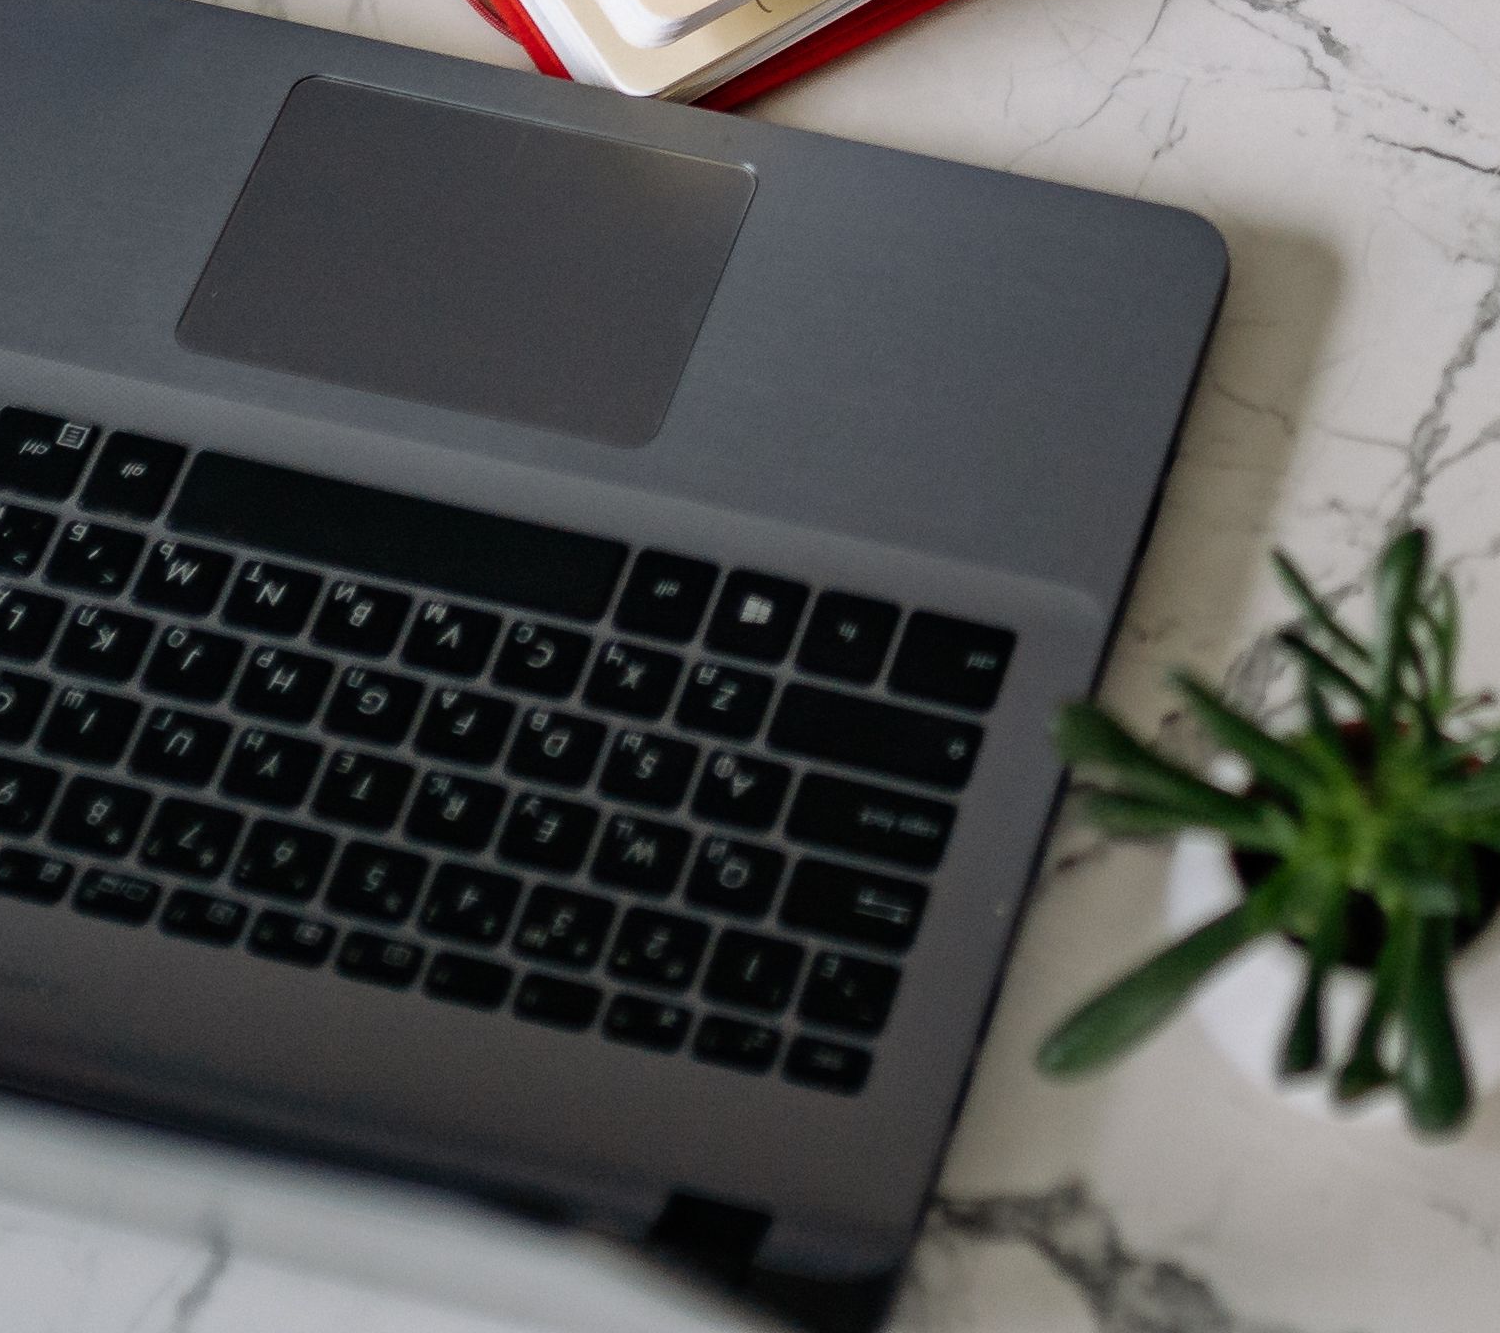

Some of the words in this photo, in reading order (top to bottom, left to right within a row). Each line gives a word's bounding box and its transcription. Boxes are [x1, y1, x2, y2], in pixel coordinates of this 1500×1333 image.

[18, 439, 50, 455] ctrl
[120, 463, 146, 477] alt
[166, 559, 198, 585] M
[256, 581, 286, 605] N
[8, 607, 26, 629] L
[350, 603, 372, 627] B
[90, 627, 118, 651] K
[438, 625, 460, 647] V
[180, 647, 200, 669] J
[522, 637, 554, 669] C
[268, 667, 296, 691] H
[622, 665, 644, 689] X
[358, 689, 388, 715] G
[712, 685, 736, 711] Z
[80, 711, 96, 733] I
[454, 713, 476, 735] F
[166, 729, 194, 755] U
[544, 731, 570, 757] D
[260, 753, 278, 775] Y
[638, 753, 658, 779] S
[352, 775, 372, 799] T
[732, 773, 754, 797] A
[86, 799, 110, 825] 8
[444, 795, 466, 821] R
[178, 825, 200, 849] 7
[536, 817, 558, 843] E
[626, 839, 656, 863] W
[364, 865, 386, 891] 5
[720, 857, 748, 887] Q
[460, 889, 478, 909] 4
[646, 931, 668, 959] 2
